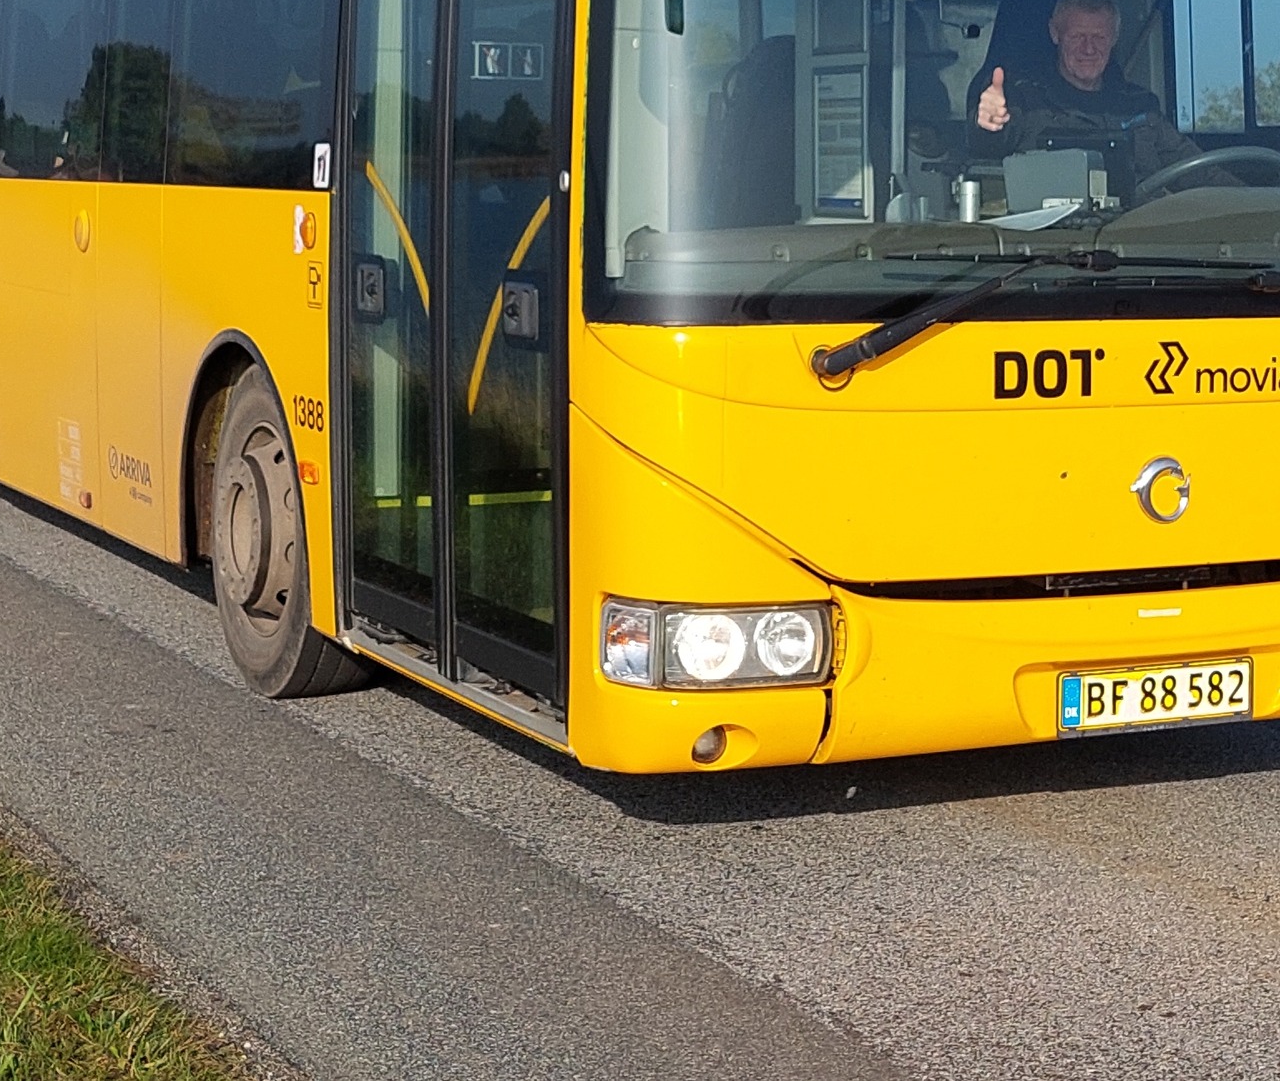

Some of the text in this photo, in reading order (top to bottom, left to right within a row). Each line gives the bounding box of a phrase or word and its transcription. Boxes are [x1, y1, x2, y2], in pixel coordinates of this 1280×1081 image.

[994, 348, 1106, 399] DOT
[292, 394, 325, 432] 1388
[120, 453, 152, 488] ARRIVA
[1086, 669, 1244, 717] BF 88 582
[1063, 706, 1079, 719] DK
